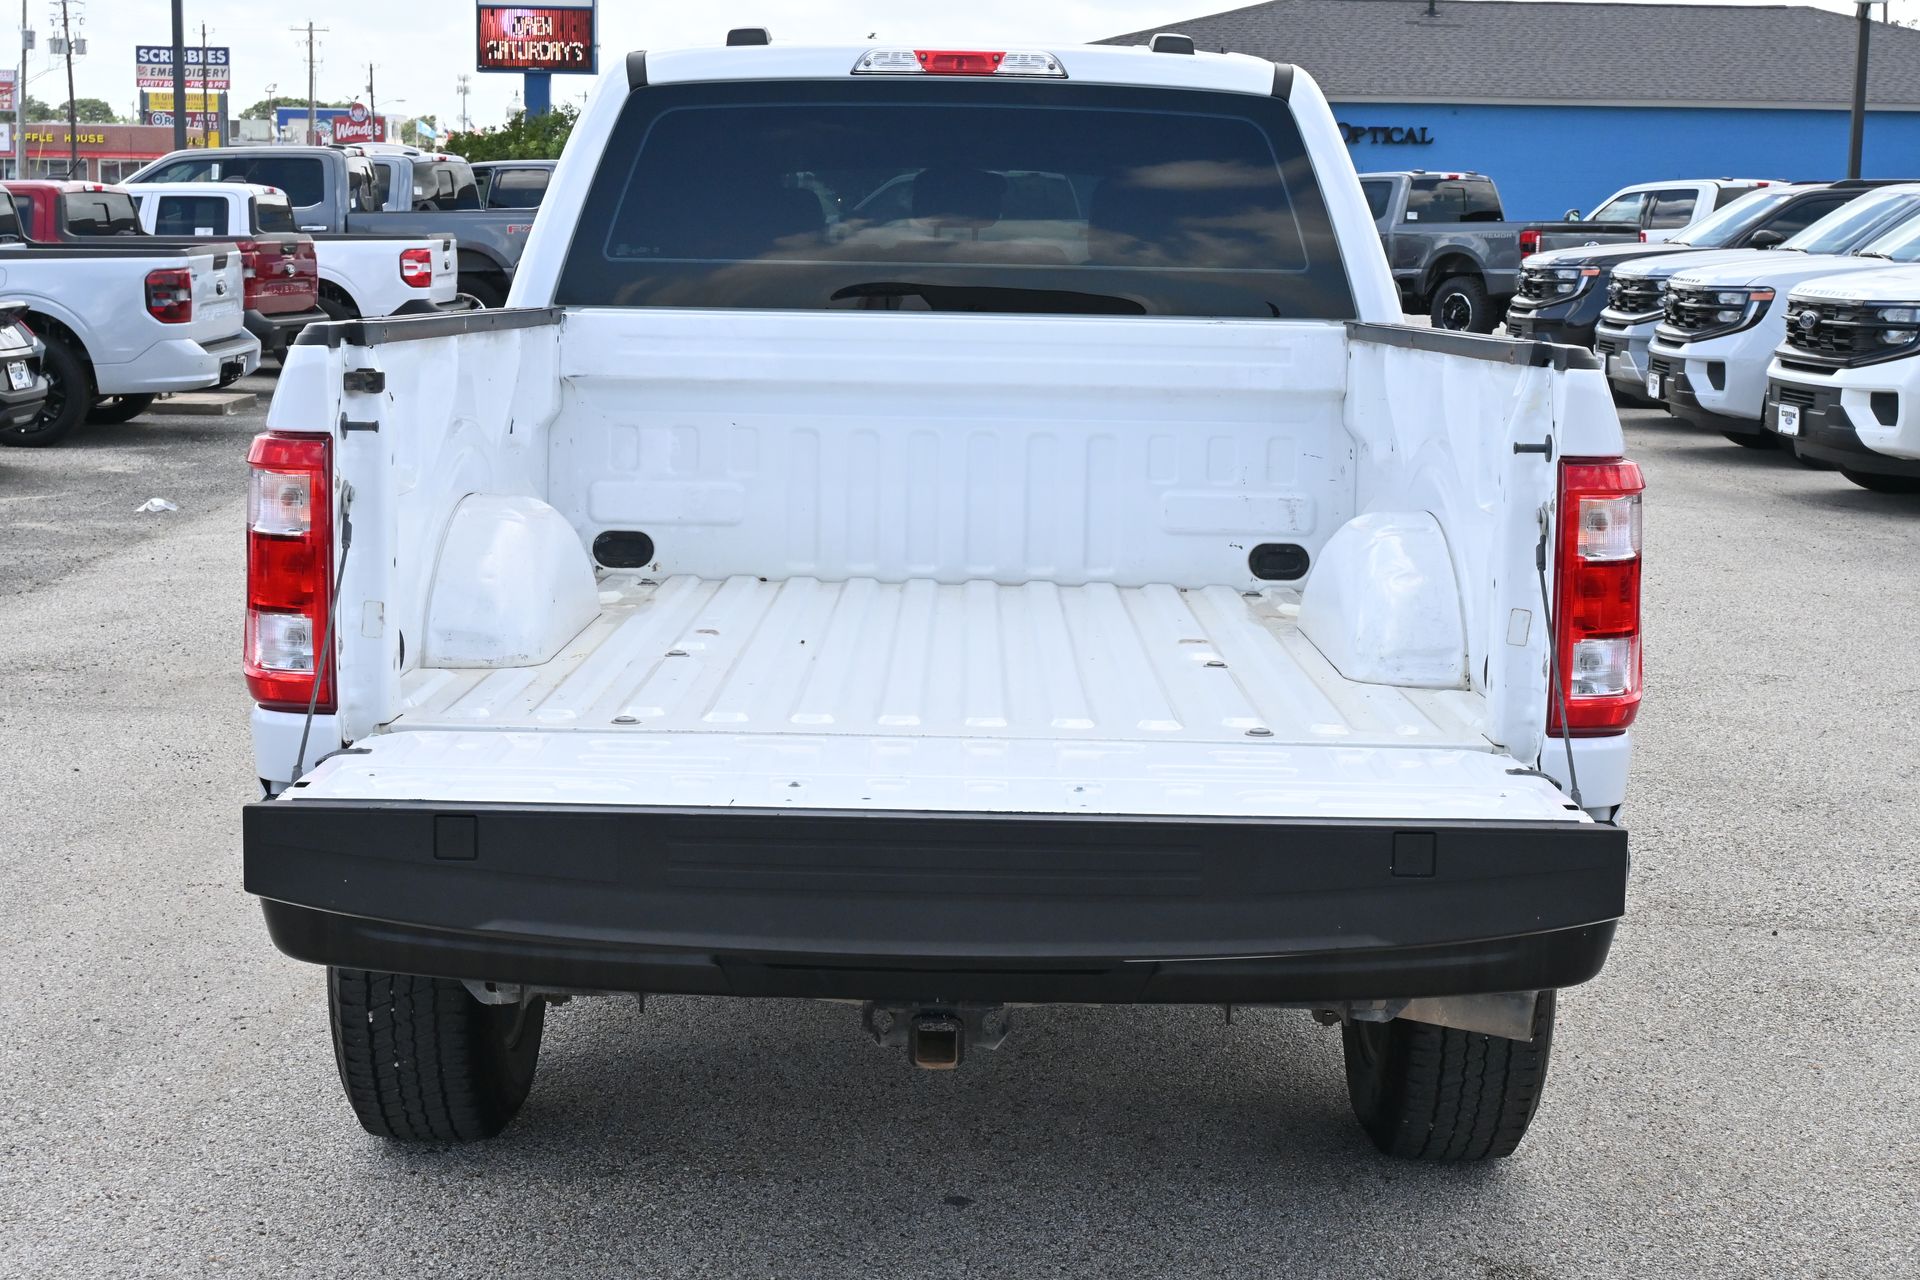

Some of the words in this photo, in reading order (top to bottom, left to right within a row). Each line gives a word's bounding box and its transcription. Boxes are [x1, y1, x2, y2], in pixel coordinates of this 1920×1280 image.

[514, 16, 553, 35] OPEN
[139, 49, 226, 63] SCRIBLES
[150, 67, 227, 78] EMBOIDERY
[194, 122, 218, 130] PATS
[336, 121, 382, 140] Wendy's
[1337, 122, 1434, 144] OPTICAL
[12, 133, 53, 142] FFLE
